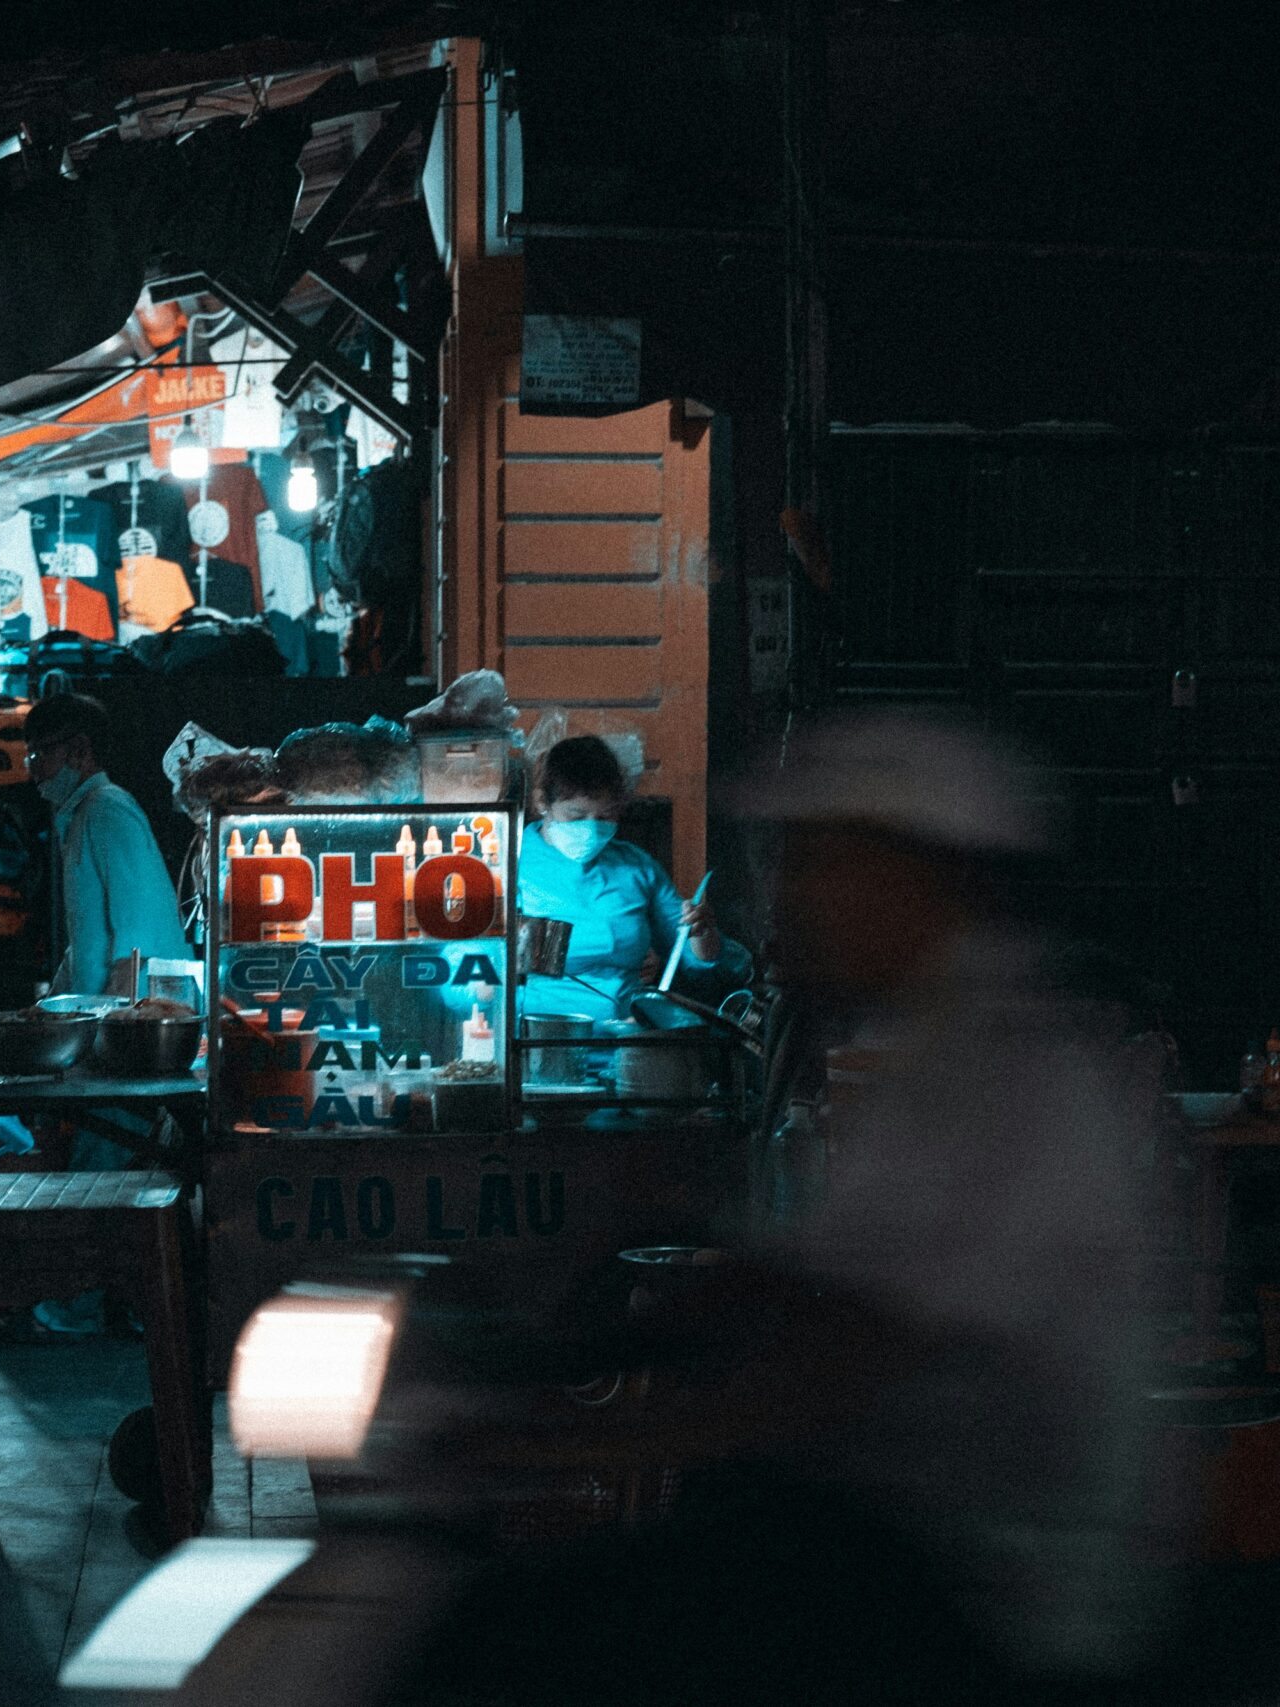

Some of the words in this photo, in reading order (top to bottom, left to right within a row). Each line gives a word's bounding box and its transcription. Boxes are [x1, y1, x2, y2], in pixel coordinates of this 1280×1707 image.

[228, 942, 378, 991] CÂY
[256, 1176, 396, 1242] CAO
[426, 1153, 566, 1241] LÂU
